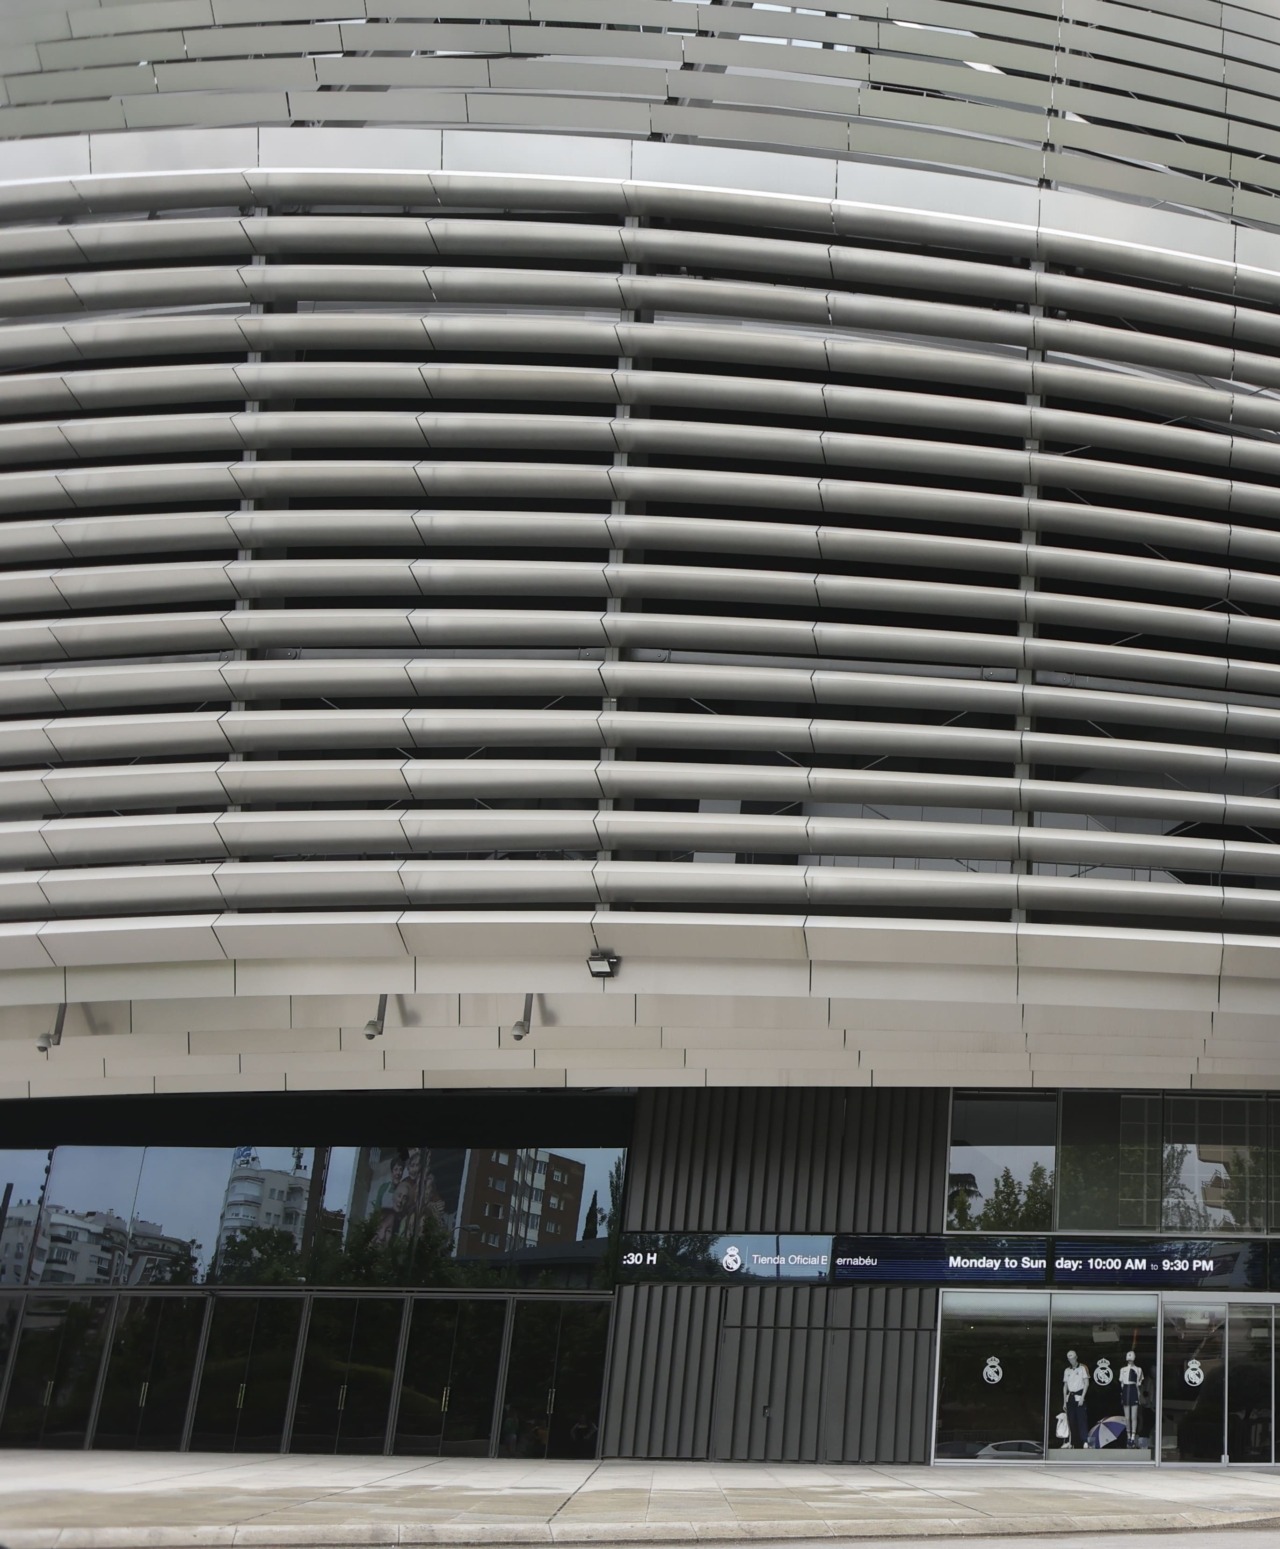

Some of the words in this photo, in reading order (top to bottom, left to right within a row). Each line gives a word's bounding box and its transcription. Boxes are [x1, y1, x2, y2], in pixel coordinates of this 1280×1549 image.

[646, 1252, 658, 1265] H
[751, 1254, 785, 1265] Tienda
[787, 1254, 820, 1265] Oficial
[948, 1255, 1002, 1271] Monday
[1004, 1256, 1018, 1269] to
[1087, 1257, 1122, 1270] 10:00
[1124, 1258, 1147, 1271] AM
[1161, 1259, 1190, 1271] 9:30
[1192, 1259, 1214, 1272] PM
